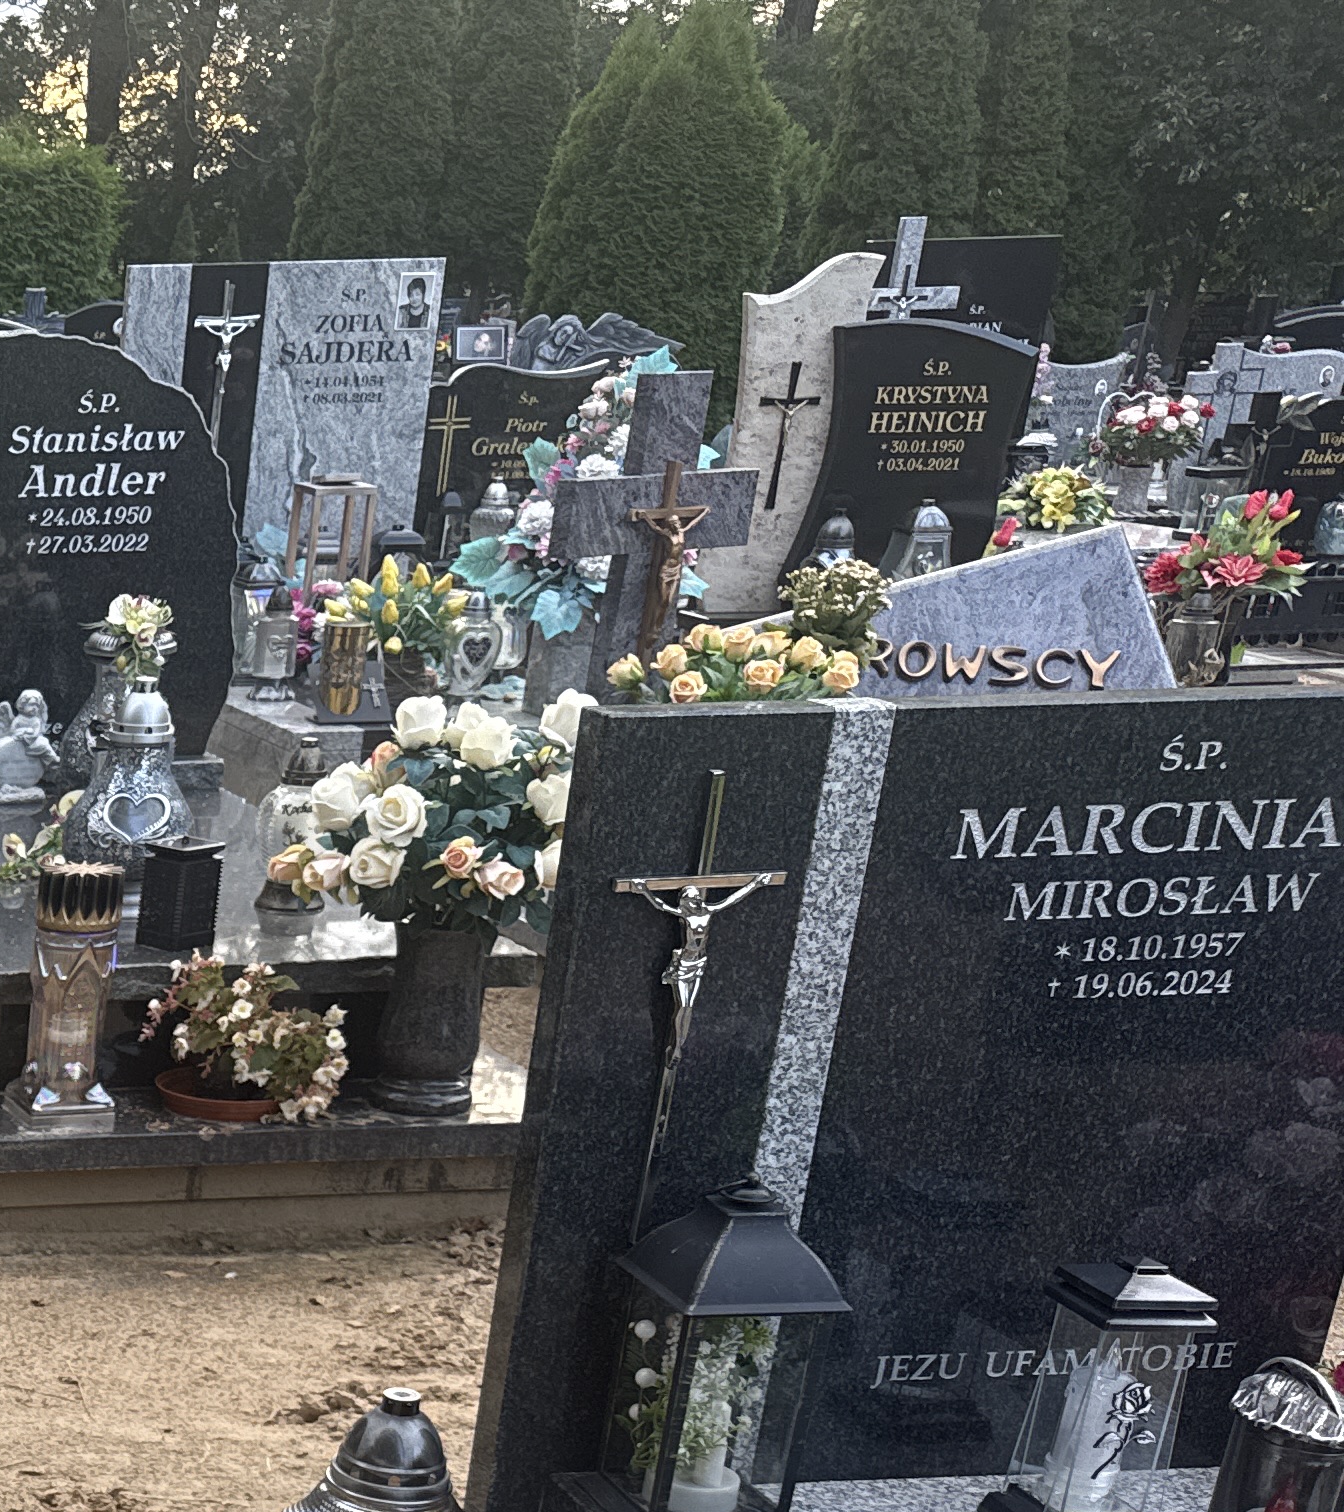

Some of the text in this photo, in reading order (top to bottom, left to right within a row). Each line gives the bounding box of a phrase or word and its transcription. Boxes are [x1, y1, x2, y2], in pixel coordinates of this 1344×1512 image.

[314, 313, 385, 334] ZOFIA
[278, 339, 414, 365] SAJDERA
[923, 357, 953, 377] Ś.P.
[77, 389, 120, 414] Ś.P.
[874, 385, 990, 405] KRYSTYNA
[504, 417, 548, 433] Piotr
[868, 410, 988, 434] HEINICH
[8, 423, 186, 455] Stanisław
[889, 439, 966, 455] 30.01.1950
[886, 457, 960, 472] 03.04.2021
[17, 462, 167, 498] Andler
[39, 505, 153, 527] 24.08.1950
[37, 532, 150, 554] 27.03.2022
[1159, 734, 1228, 772] Ś.P.
[1003, 871, 1322, 922] MIROSŁAW
[1081, 931, 1247, 964] 18.10.1957
[1072, 968, 1235, 1000] 19.06.2024
[870, 1340, 1238, 1390] JEZU UFAM TOBIE
